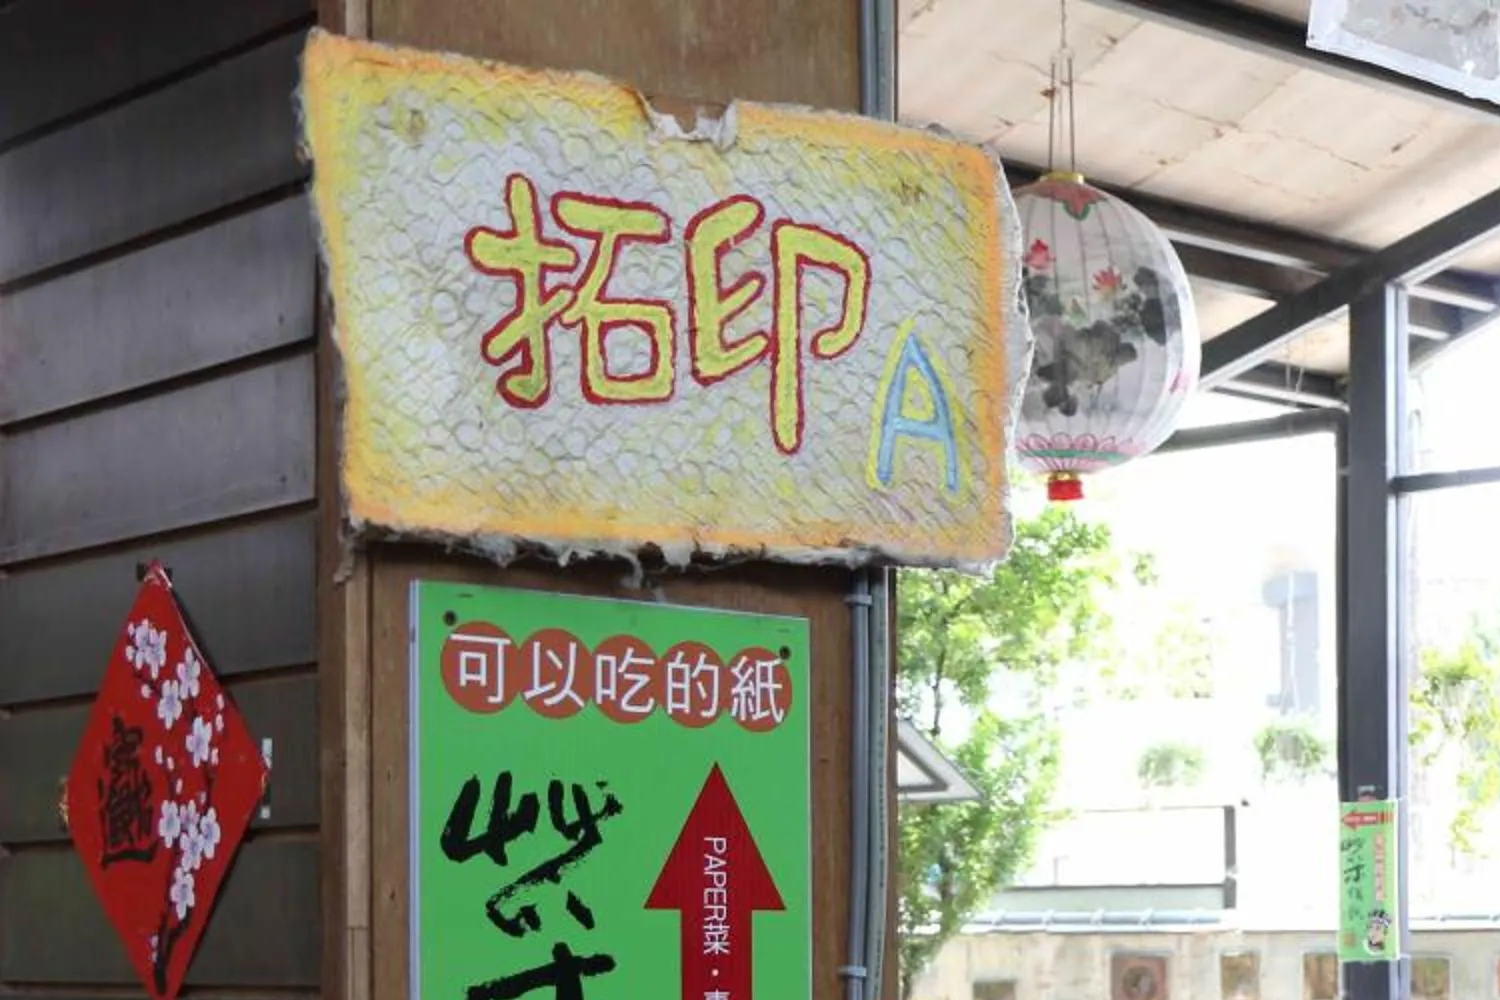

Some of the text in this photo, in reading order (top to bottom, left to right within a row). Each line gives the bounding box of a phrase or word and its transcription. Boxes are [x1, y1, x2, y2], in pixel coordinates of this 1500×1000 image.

[463, 172, 967, 497] 拓印 A
[447, 631, 785, 725] 可以吃的紙
